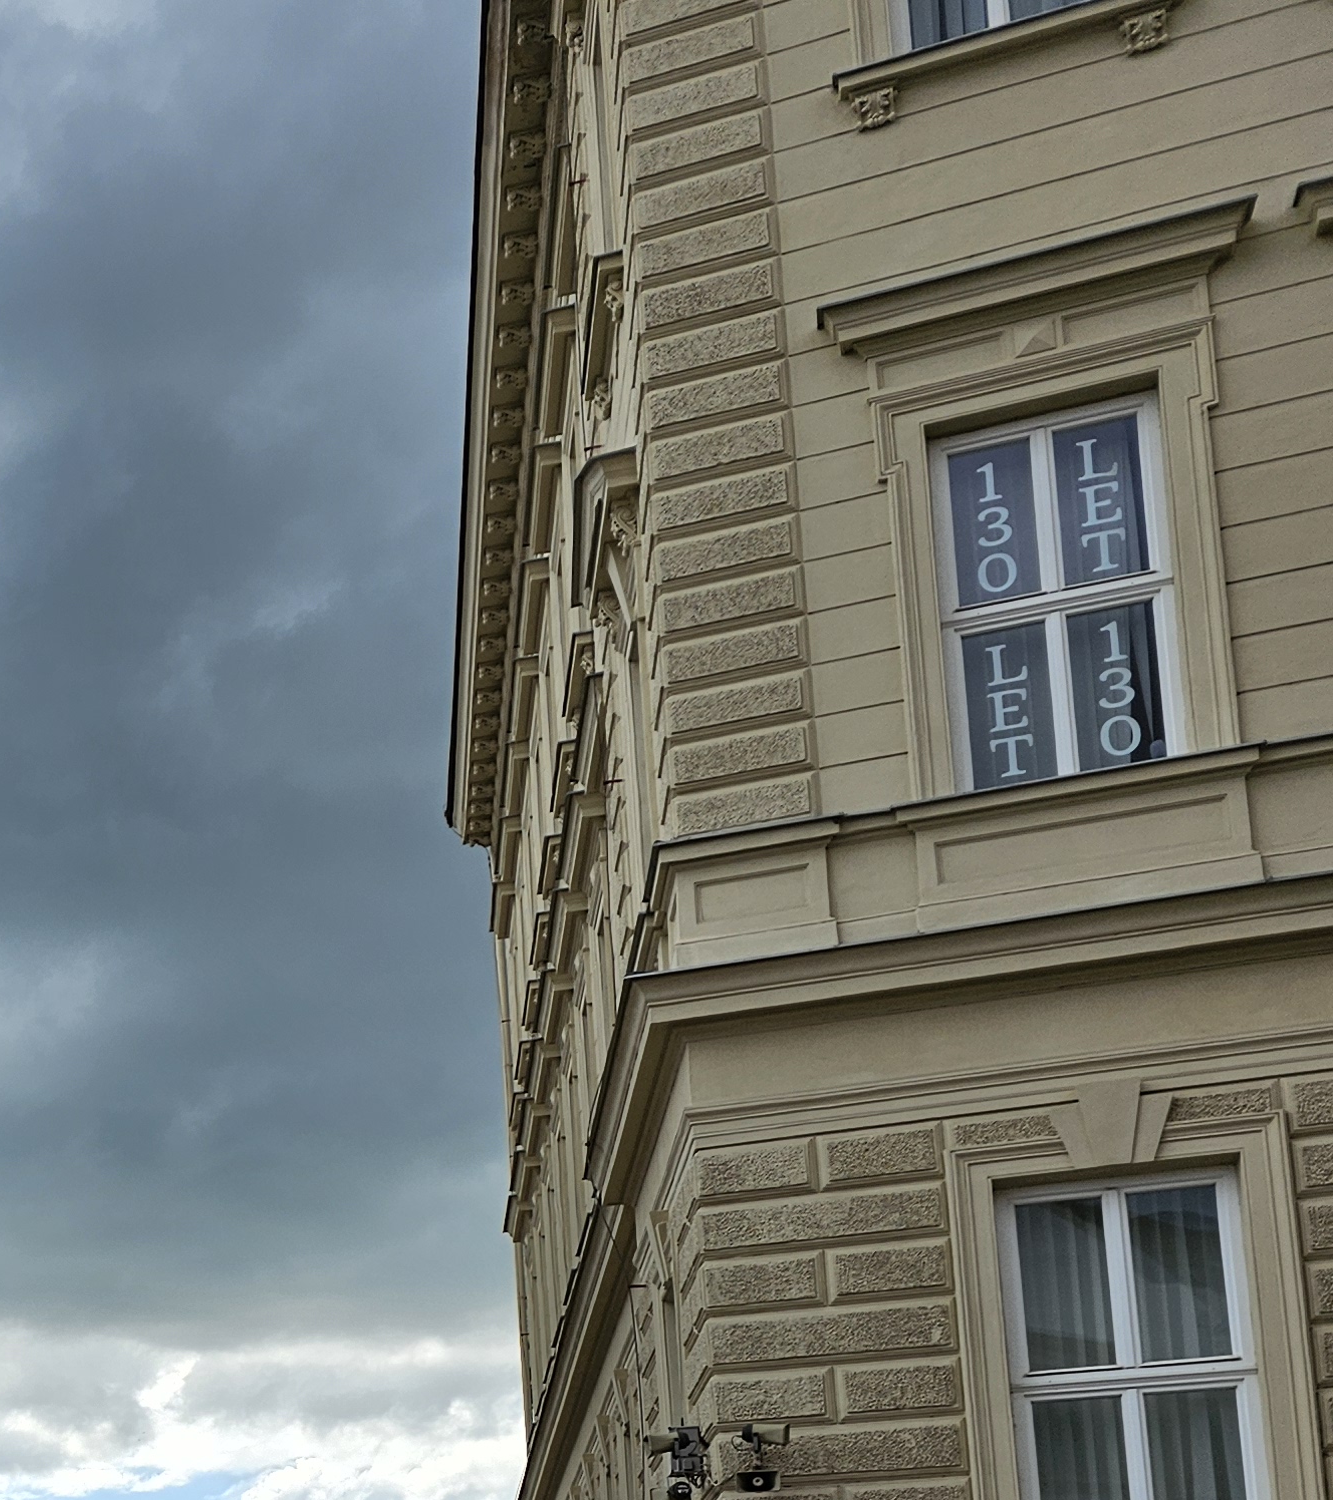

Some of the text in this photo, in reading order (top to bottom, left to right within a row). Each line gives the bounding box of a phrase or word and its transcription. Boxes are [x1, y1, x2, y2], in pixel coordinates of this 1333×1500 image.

[976, 462, 1018, 593] 130
[1075, 438, 1126, 574] LET
[984, 644, 1035, 778] LET
[1098, 621, 1142, 756] 130
